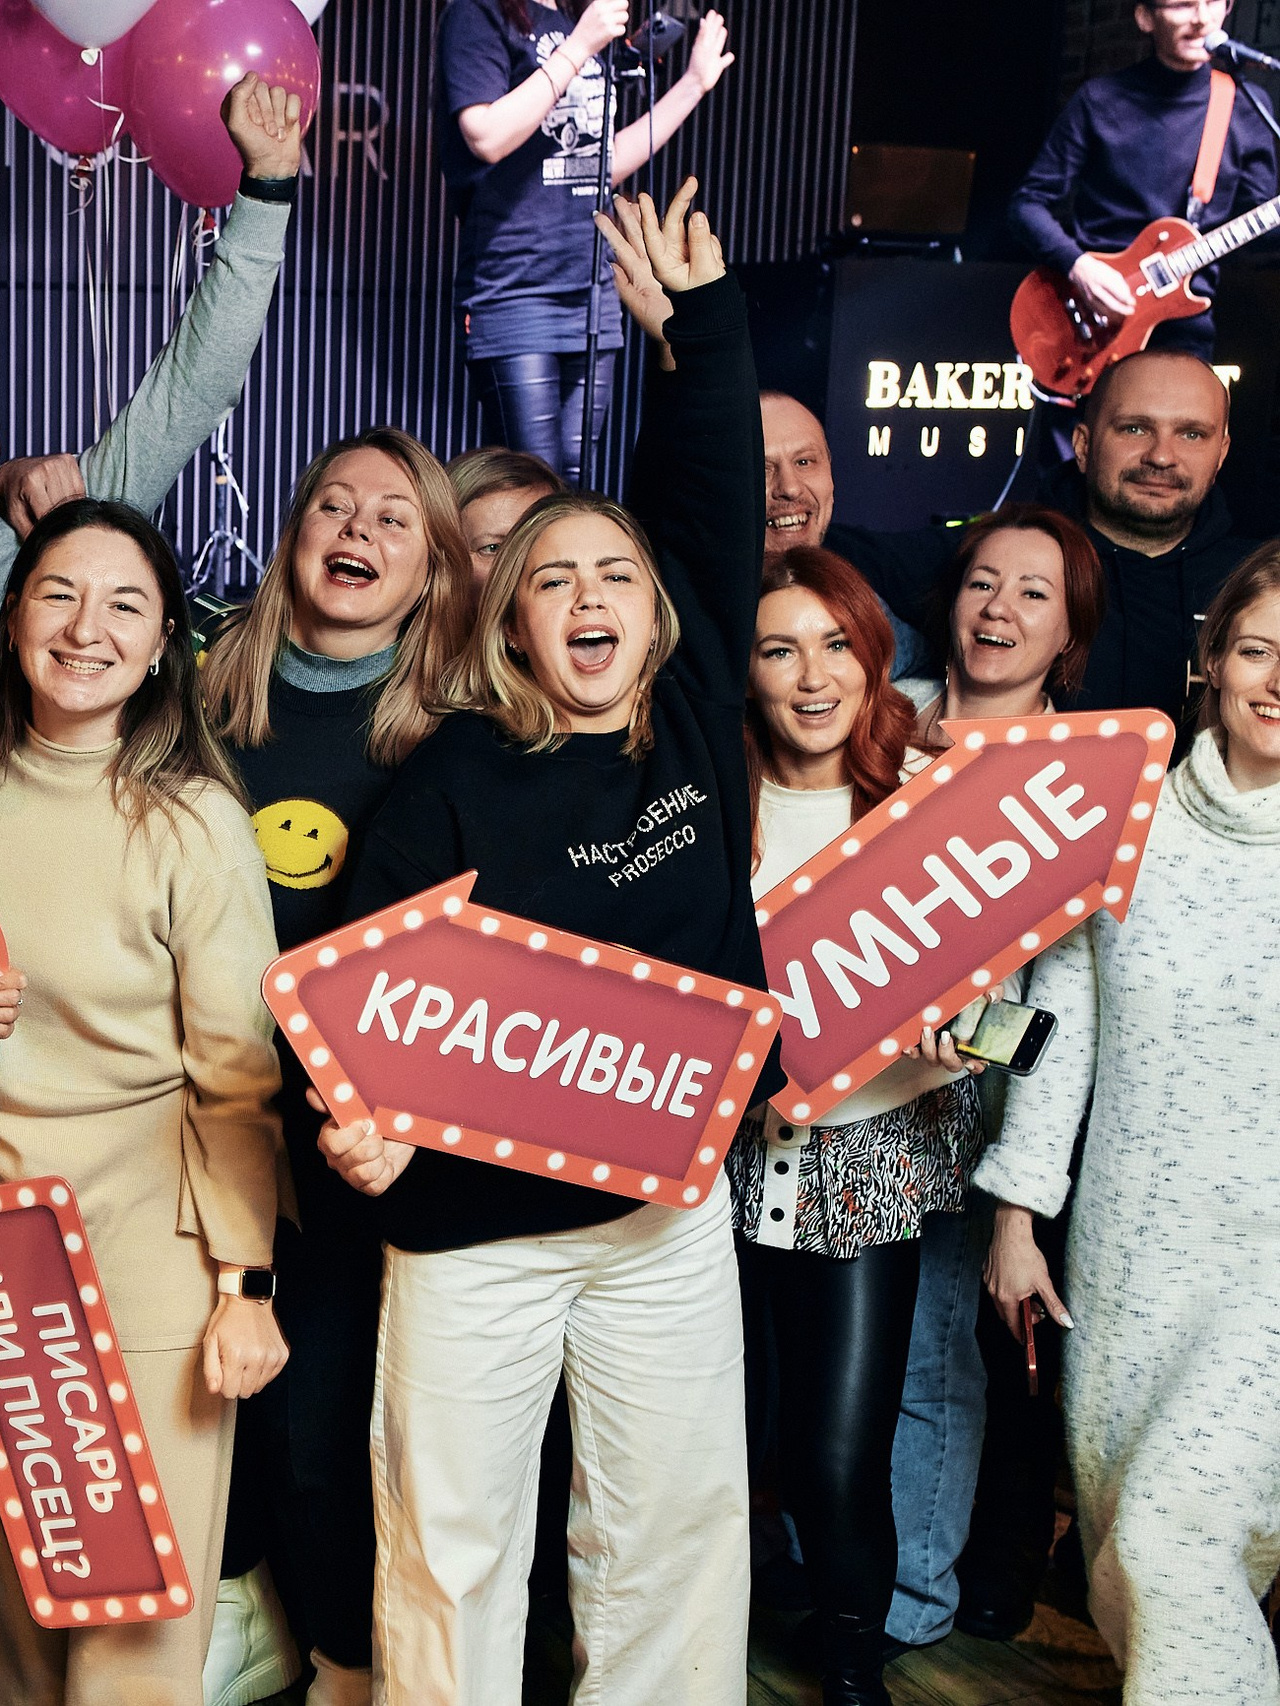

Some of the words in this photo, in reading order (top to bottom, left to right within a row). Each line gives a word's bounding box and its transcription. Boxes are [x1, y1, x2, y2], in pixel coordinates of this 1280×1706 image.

[865, 360, 1035, 411] BAKER
[608, 824, 696, 888] PROSECCO
[768, 760, 1108, 1039] УМНЫЕ
[356, 970, 713, 1118] КРАСИВЫЕ
[32, 1302, 122, 1514] ПИСАРЬ
